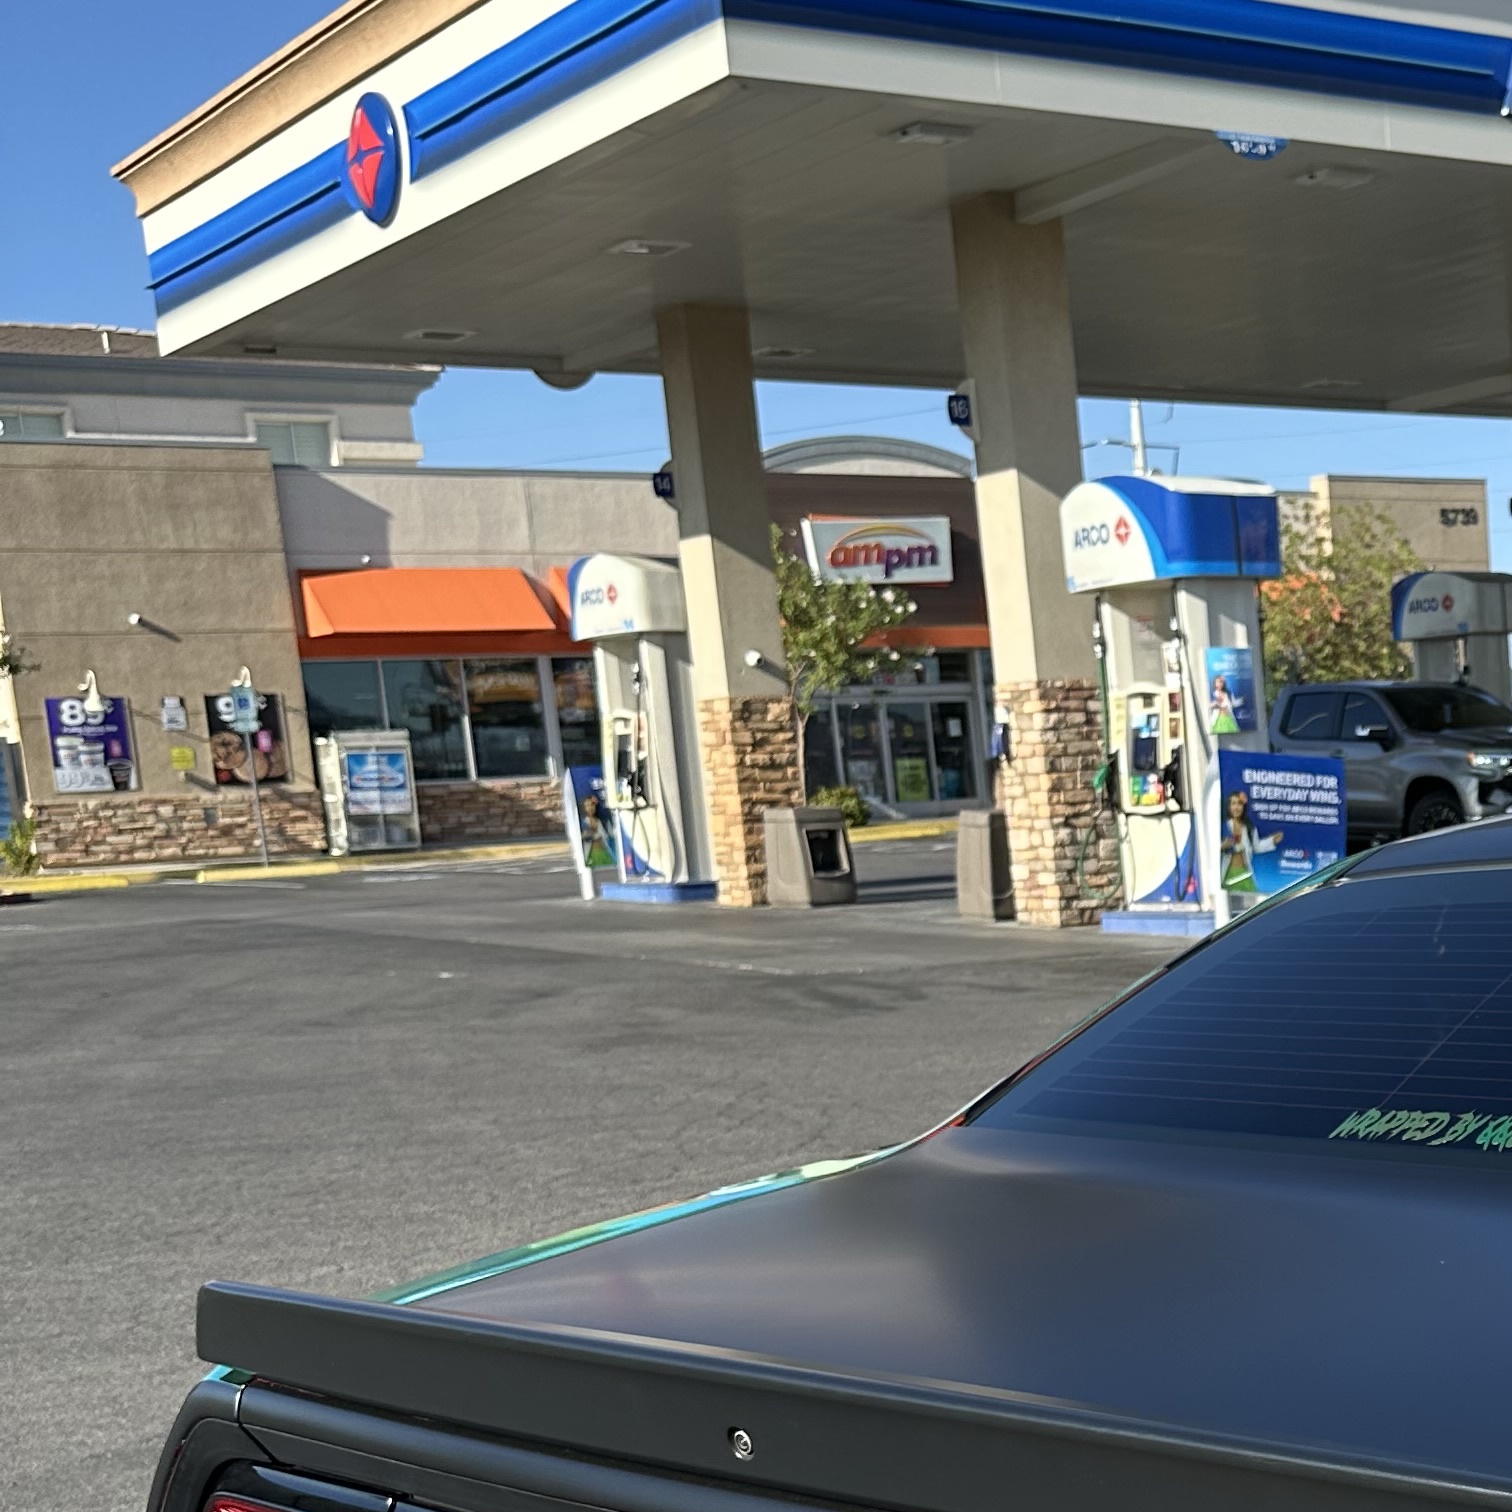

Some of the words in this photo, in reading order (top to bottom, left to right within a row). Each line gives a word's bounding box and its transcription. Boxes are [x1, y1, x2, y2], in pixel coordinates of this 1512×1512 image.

[1073, 524, 1110, 550] ARCO
[828, 543, 937, 579] ampm
[580, 586, 604, 606] ARCO
[1408, 597, 1439, 614] ARCO
[1242, 769, 1315, 788] ENGINEERED
[1315, 775, 1338, 789] FOR
[1250, 785, 1308, 801] EVERYDAY
[1309, 789, 1342, 805] WINS.
[1328, 1107, 1450, 1141] WRAPPED
[1426, 1109, 1493, 1146] BY
